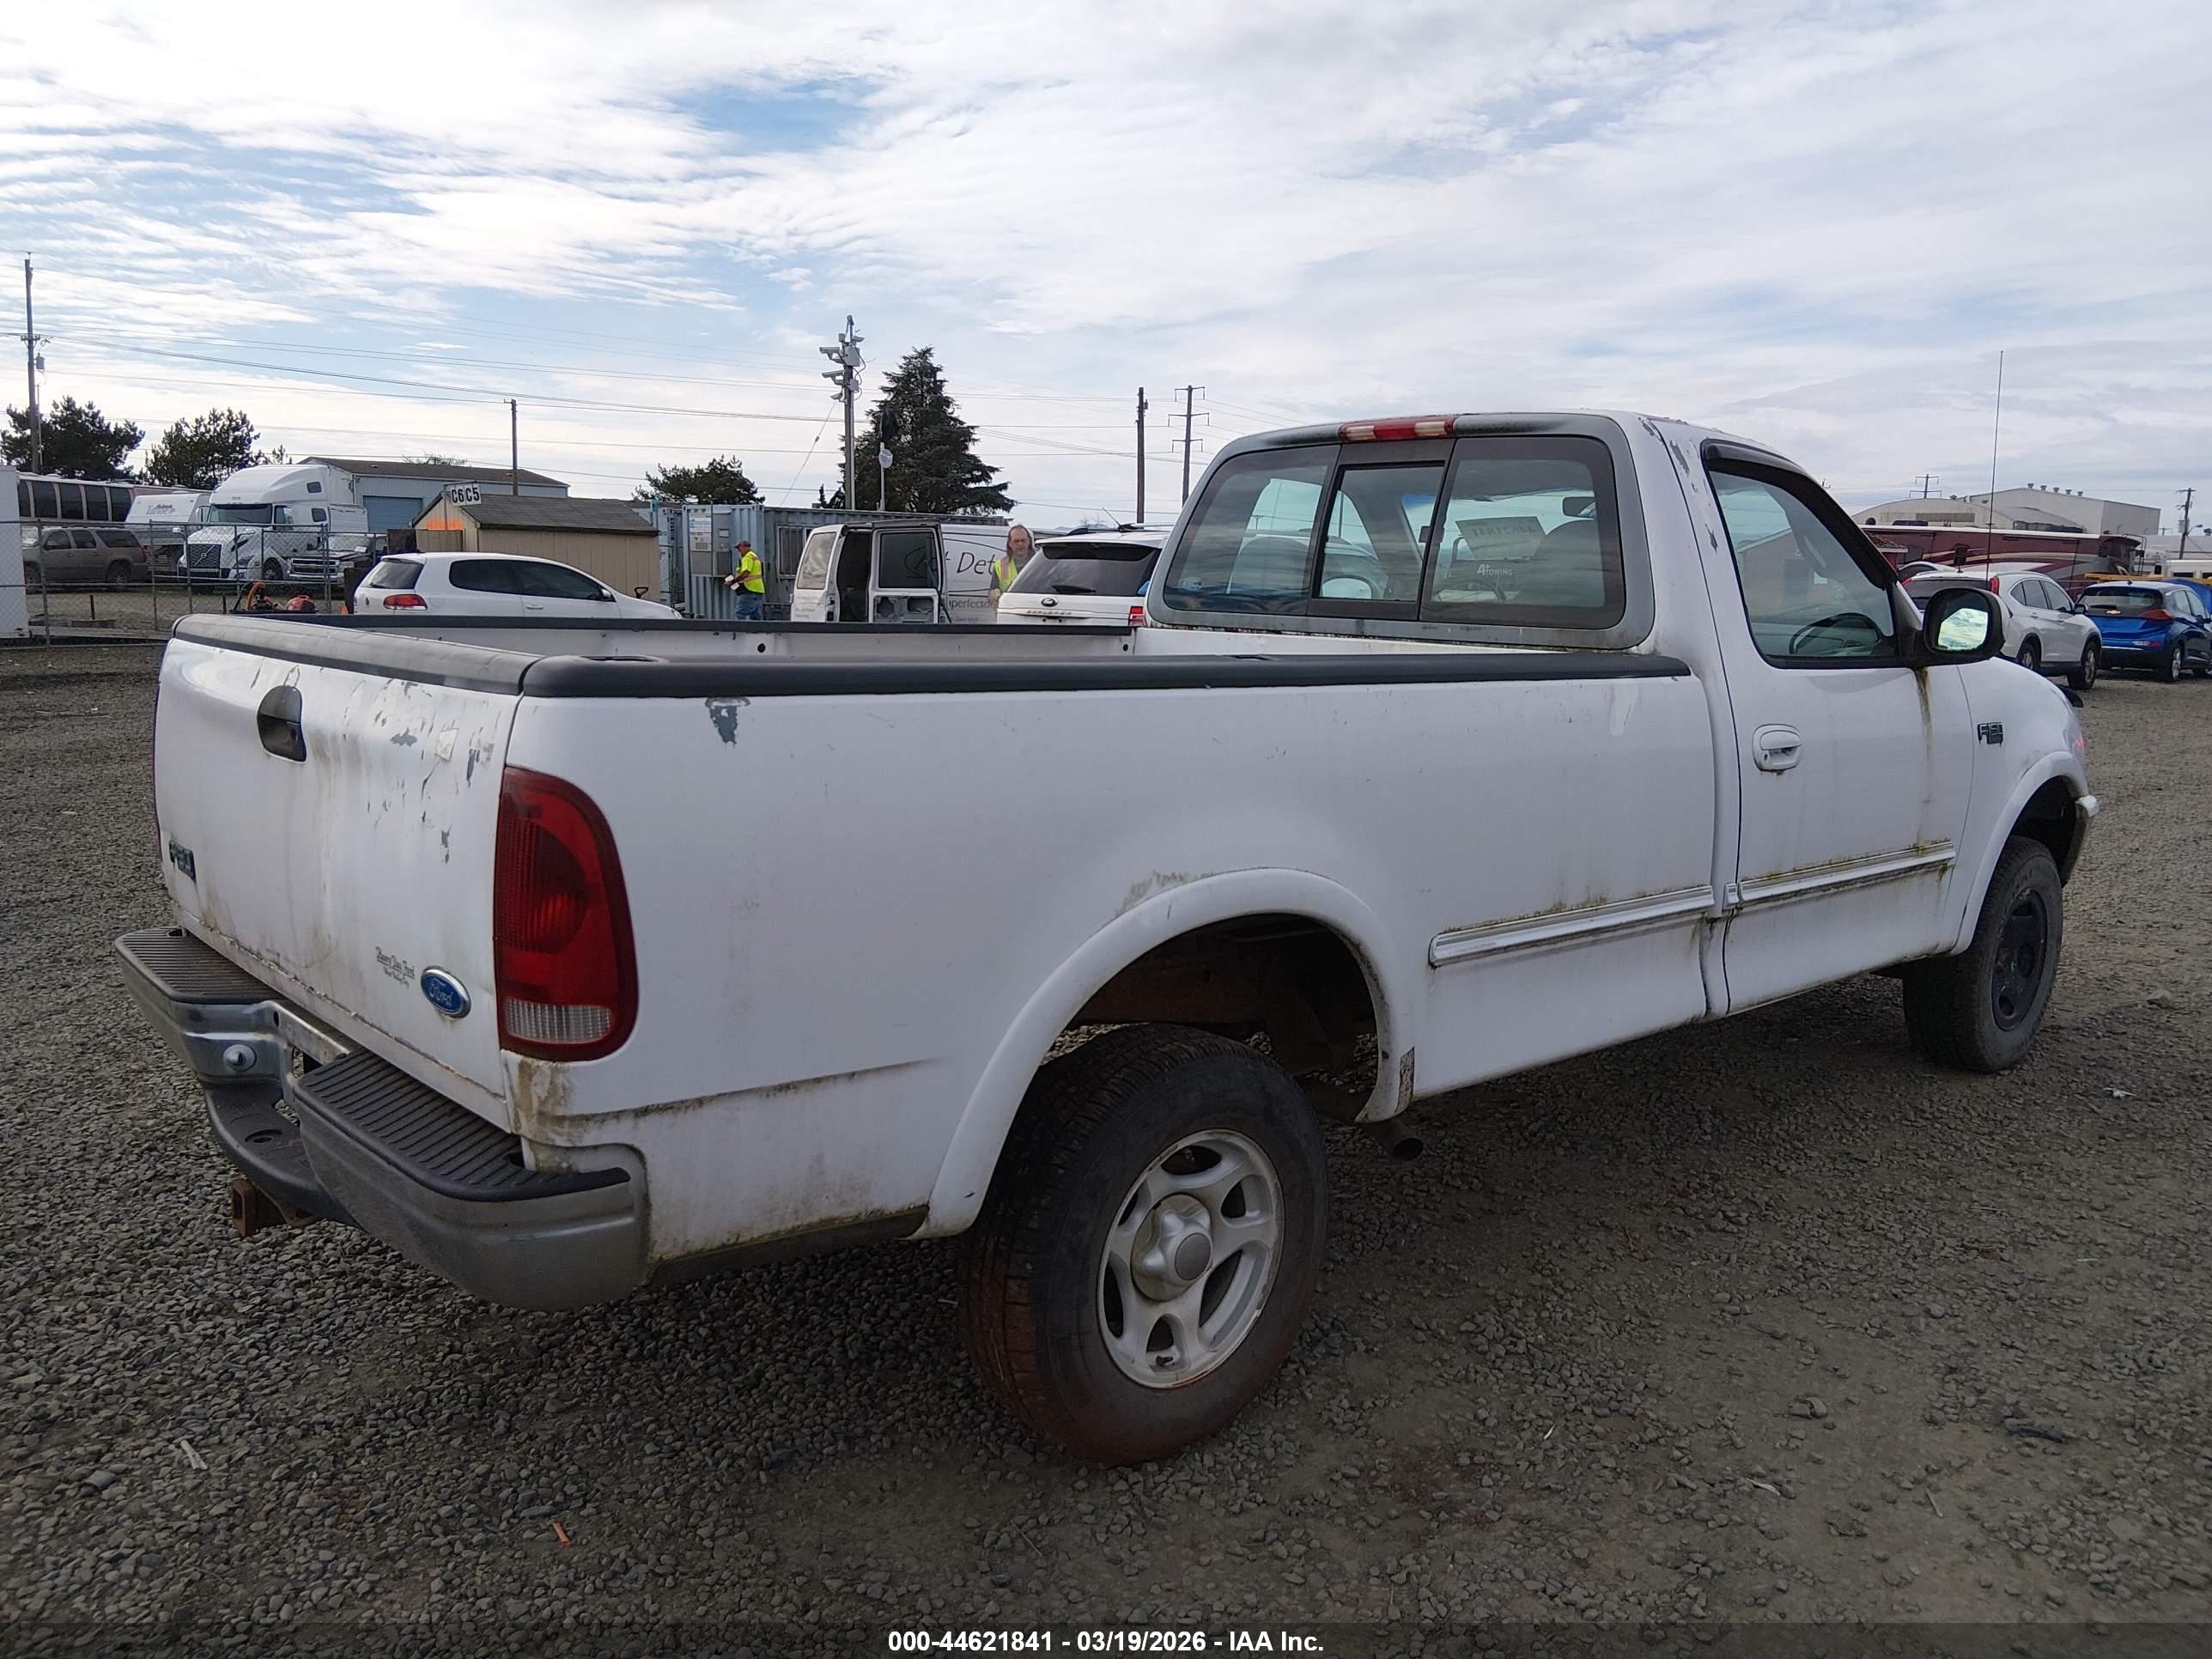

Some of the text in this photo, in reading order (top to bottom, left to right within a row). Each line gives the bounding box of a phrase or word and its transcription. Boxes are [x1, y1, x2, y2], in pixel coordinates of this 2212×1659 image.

[451, 487, 480, 503] C6 C5
[429, 977, 454, 1007] Ford
